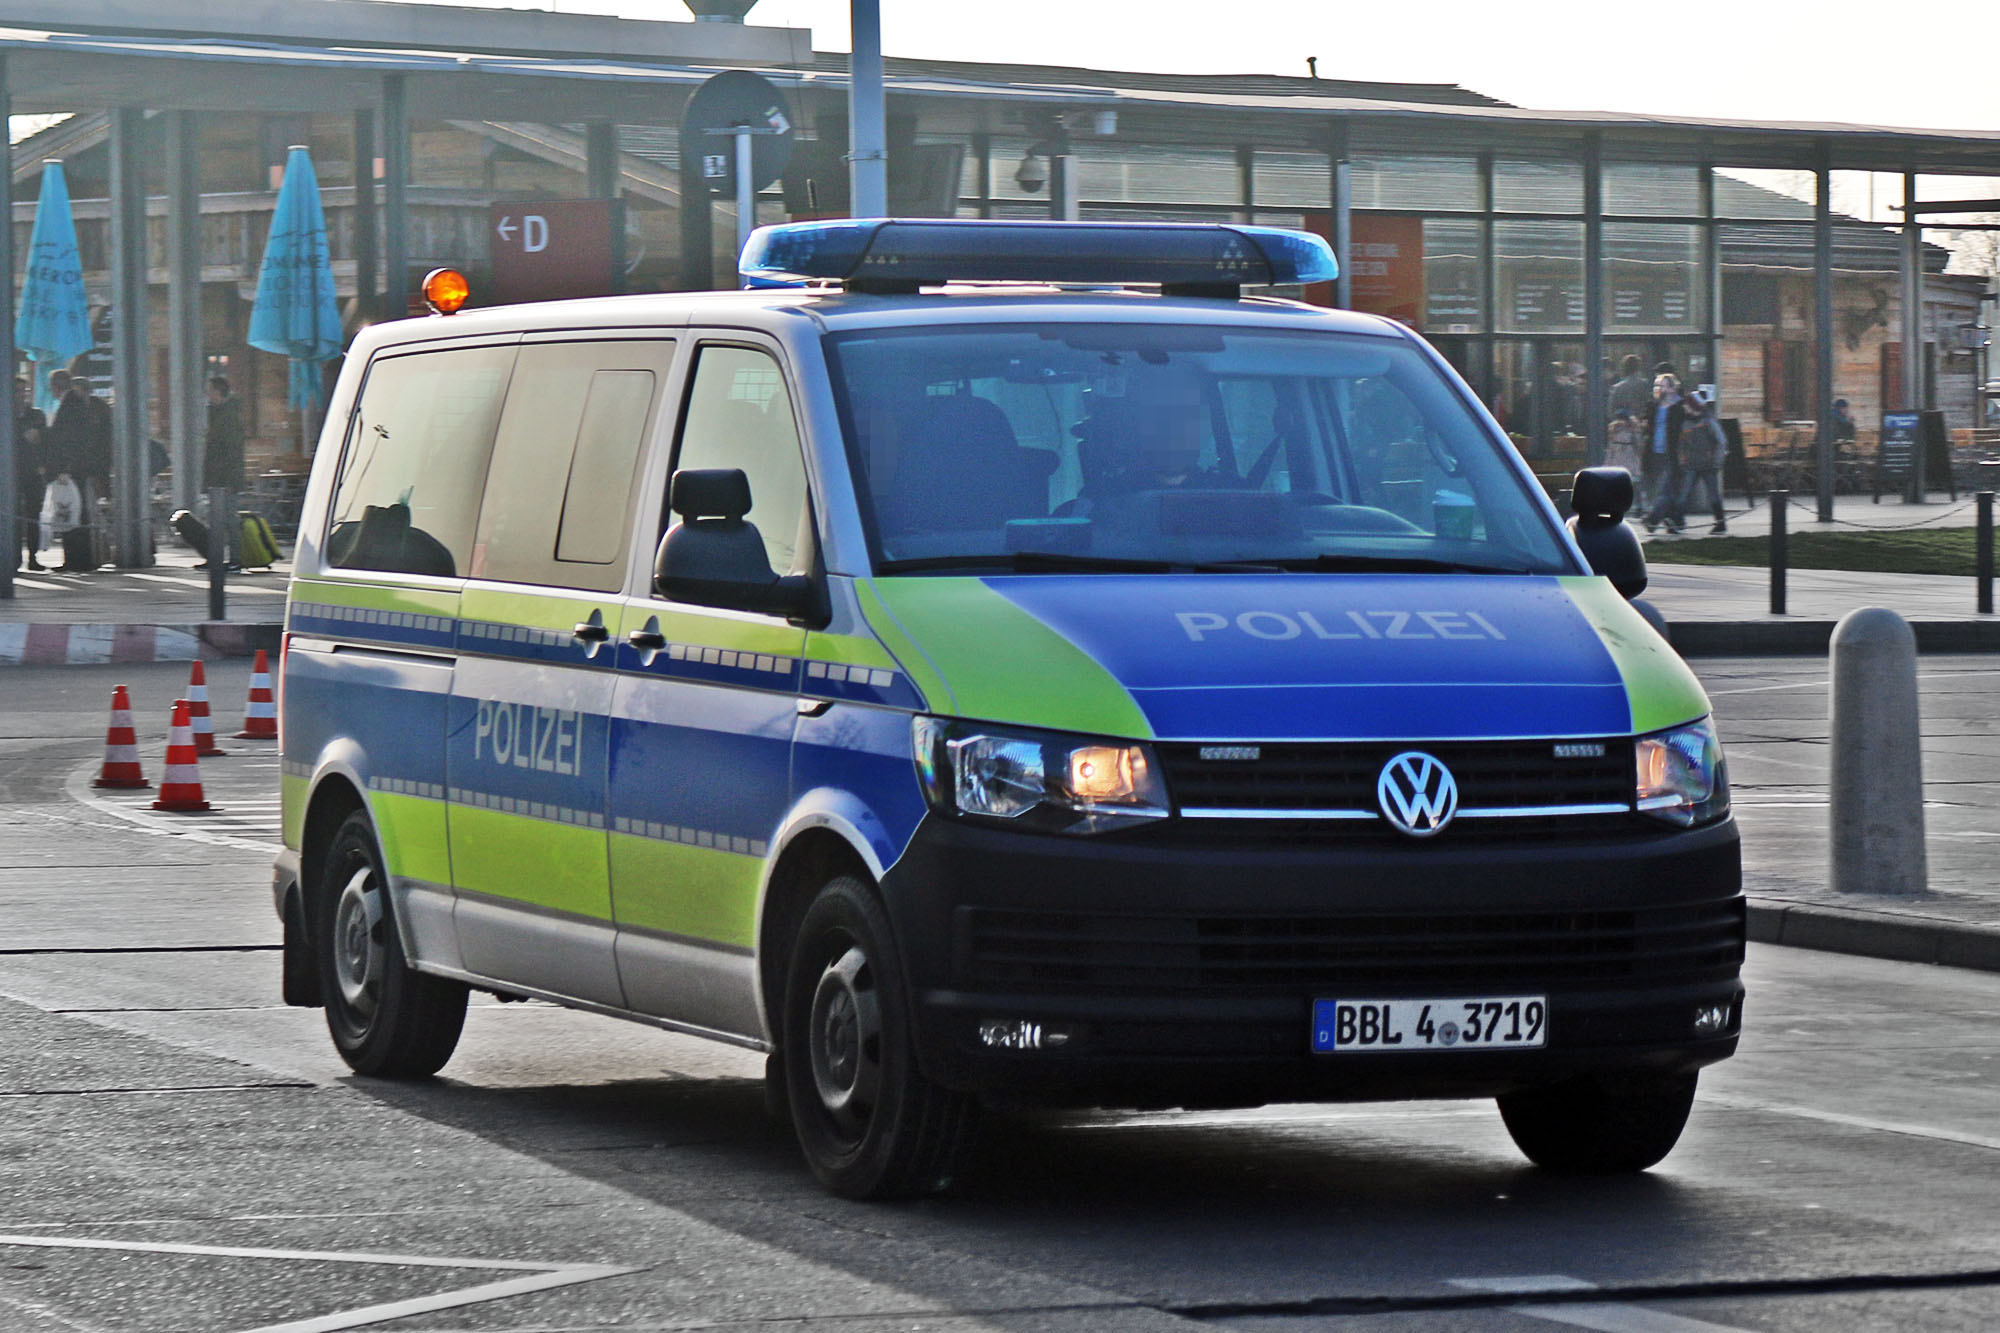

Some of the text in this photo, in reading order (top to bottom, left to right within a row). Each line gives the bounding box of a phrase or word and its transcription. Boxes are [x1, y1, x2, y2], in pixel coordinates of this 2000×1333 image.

[524, 215, 548, 252] D
[1174, 611, 1507, 642] POLIZEI
[474, 699, 583, 777] POLIZEI
[1378, 752, 1457, 835] VW
[1319, 1031, 1328, 1043] D
[1336, 1001, 1544, 1045] BBL 4 3719
